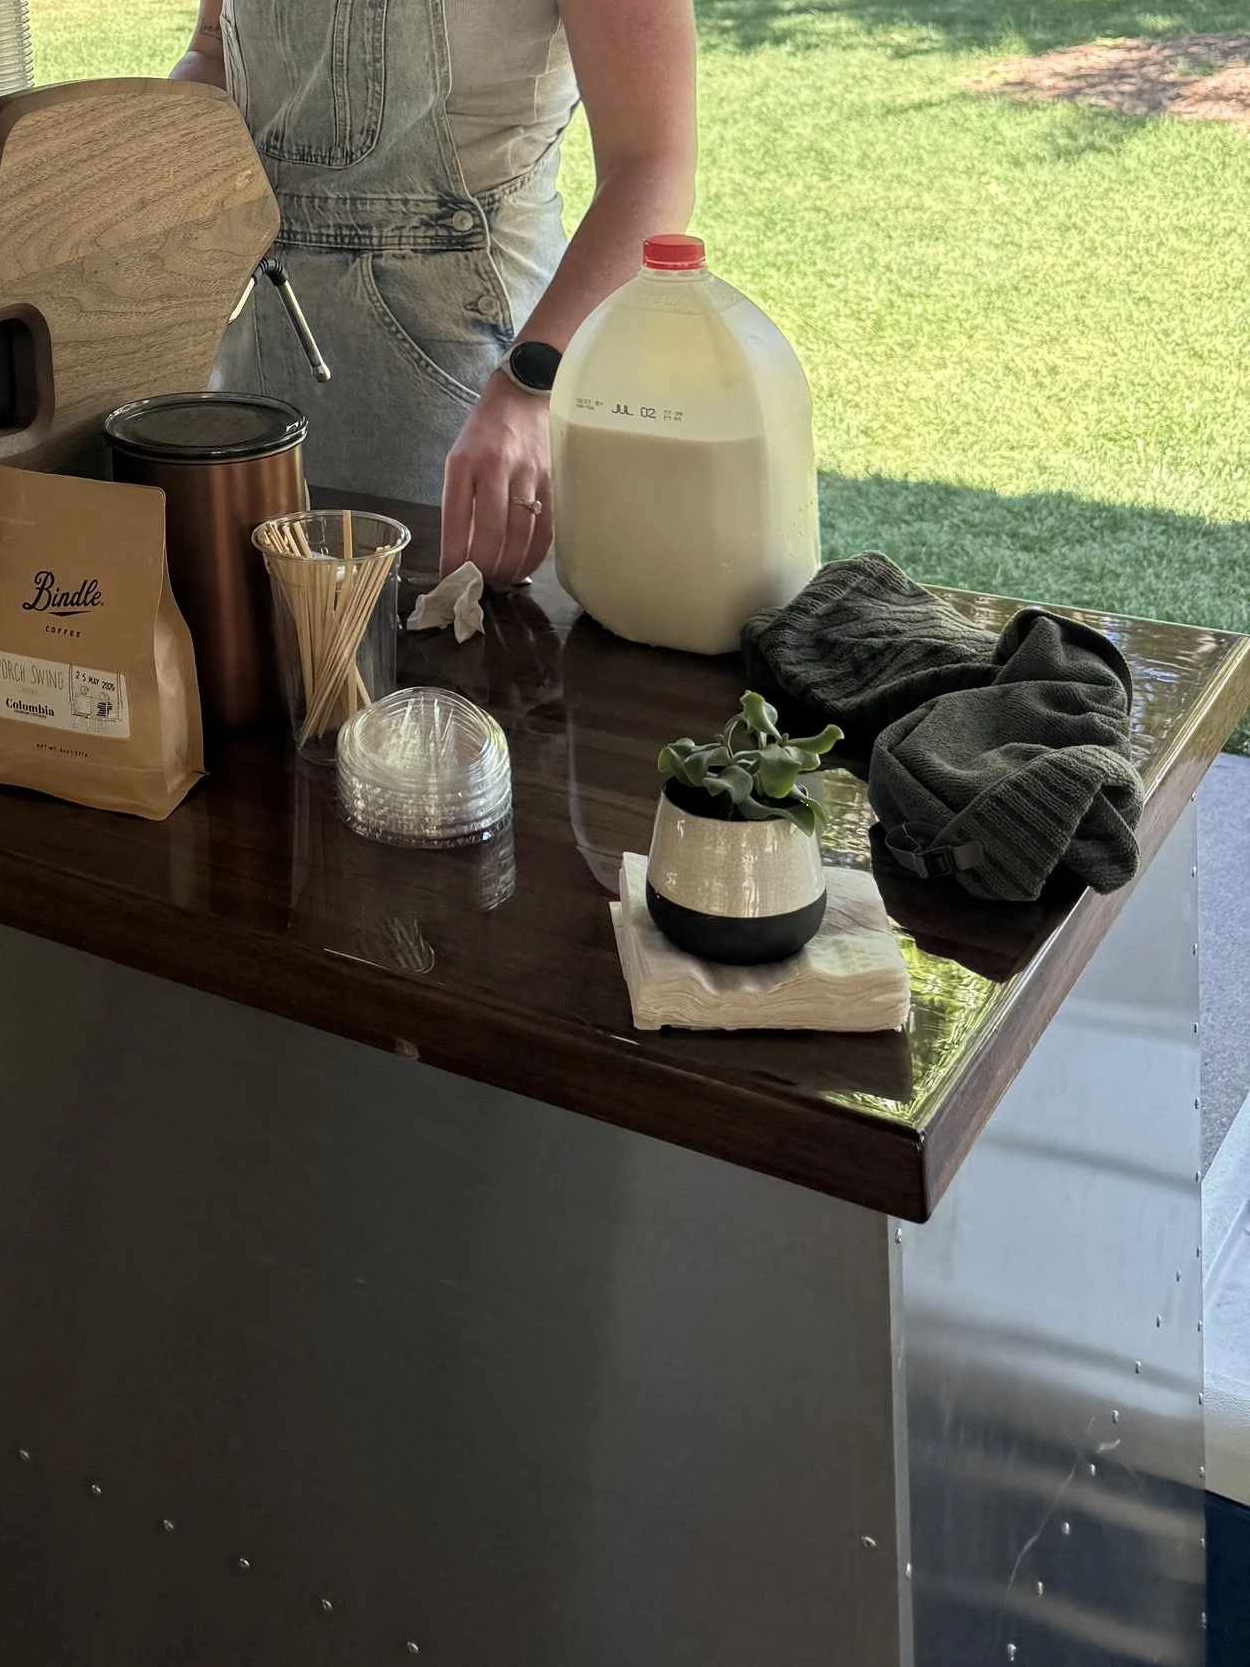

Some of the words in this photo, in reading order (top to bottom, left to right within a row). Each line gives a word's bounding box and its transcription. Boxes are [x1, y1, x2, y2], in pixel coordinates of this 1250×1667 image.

[611, 404, 634, 416] JUL
[640, 406, 656, 419] 02
[45, 625, 81, 638] COFFEE
[31, 664, 64, 690] SWING
[88, 676, 99, 686] MAY
[5, 698, 55, 717] Colombia
